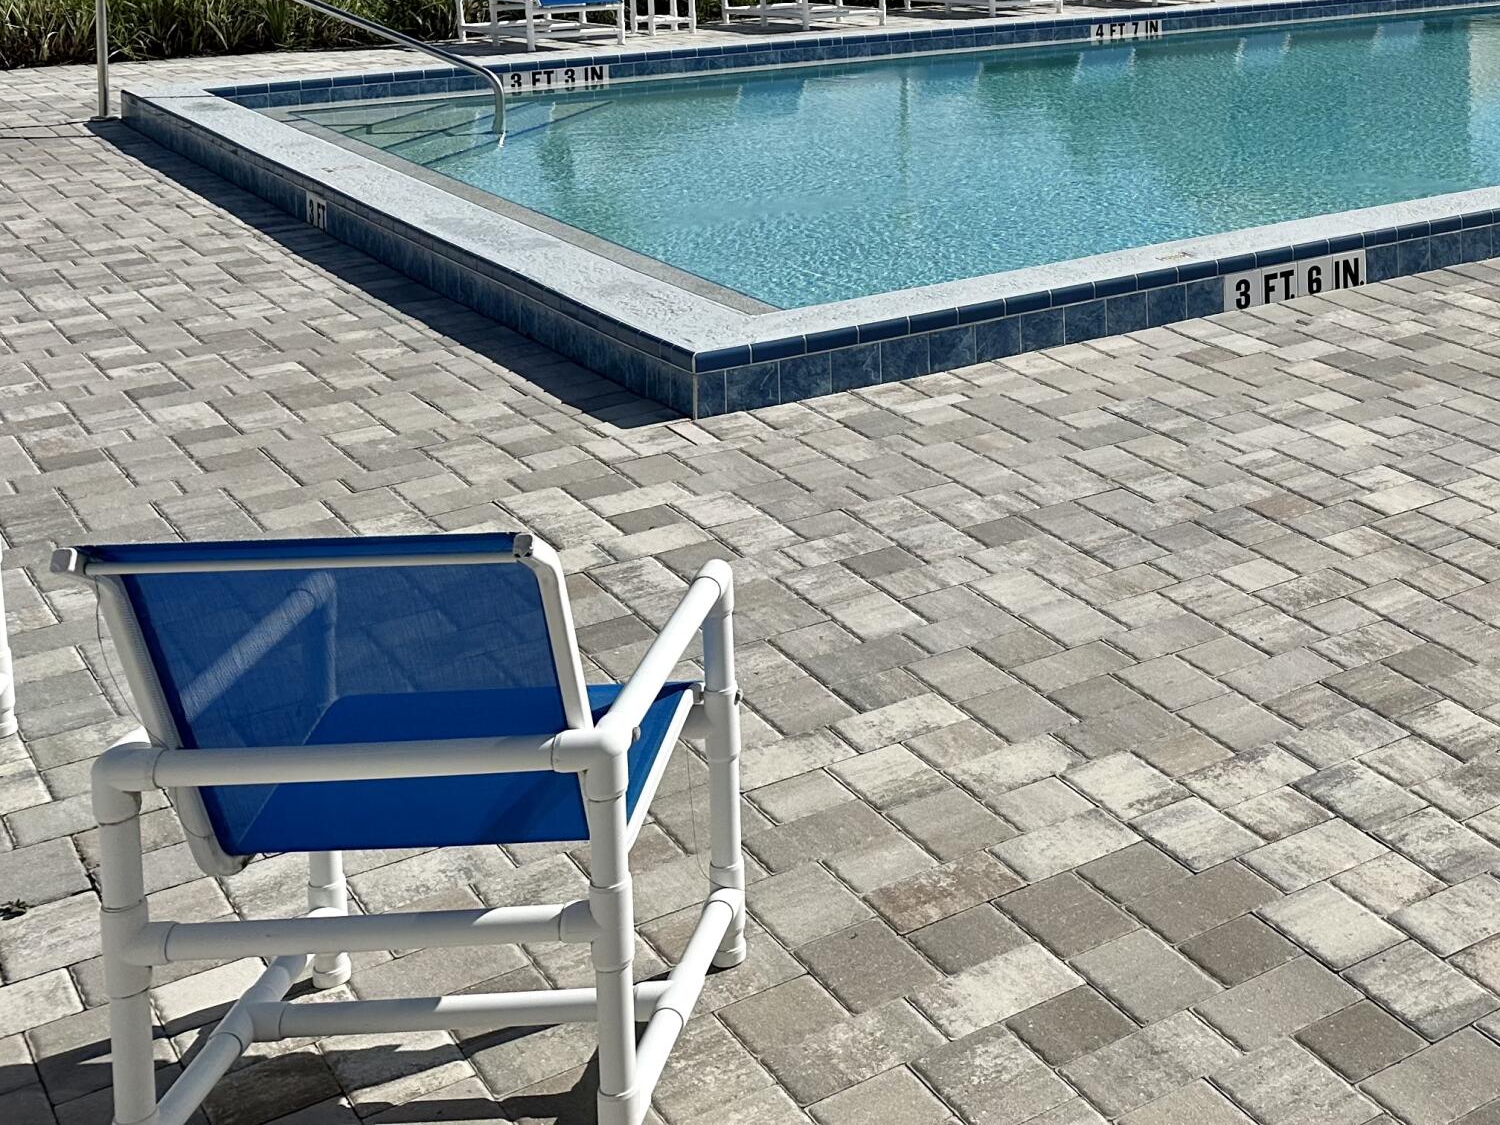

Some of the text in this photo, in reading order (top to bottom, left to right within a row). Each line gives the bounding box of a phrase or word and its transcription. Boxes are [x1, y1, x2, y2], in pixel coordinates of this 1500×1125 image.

[1095, 20, 1158, 38] 4 FT 7 IN
[510, 66, 604, 88] 3 FT 3 IN
[1235, 257, 1365, 310] 3 FT. 6 IN.
